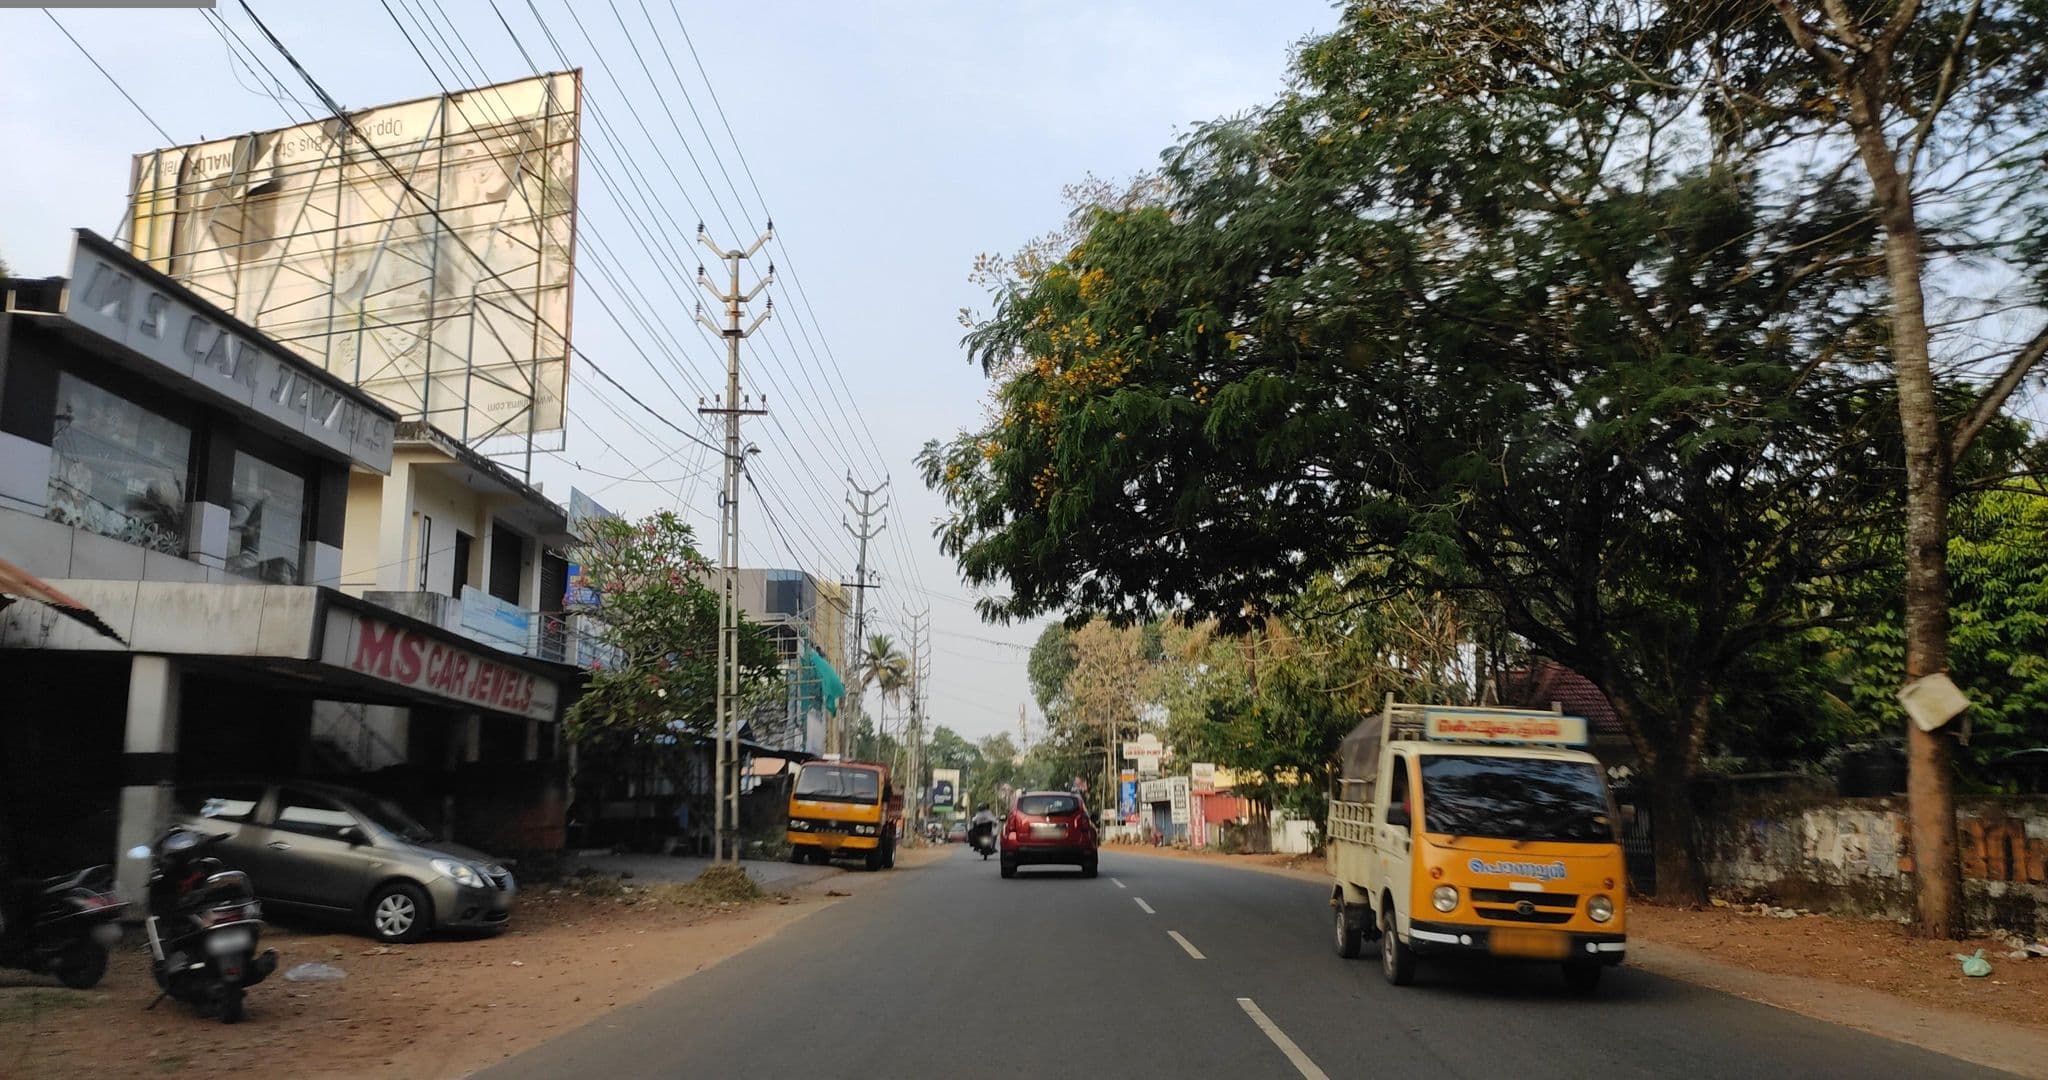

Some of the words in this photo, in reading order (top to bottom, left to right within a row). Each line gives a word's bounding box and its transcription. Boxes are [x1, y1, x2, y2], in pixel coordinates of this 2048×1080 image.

[352, 617, 425, 685] MS
[426, 644, 469, 696] CAR
[467, 660, 536, 713] JEWELS
